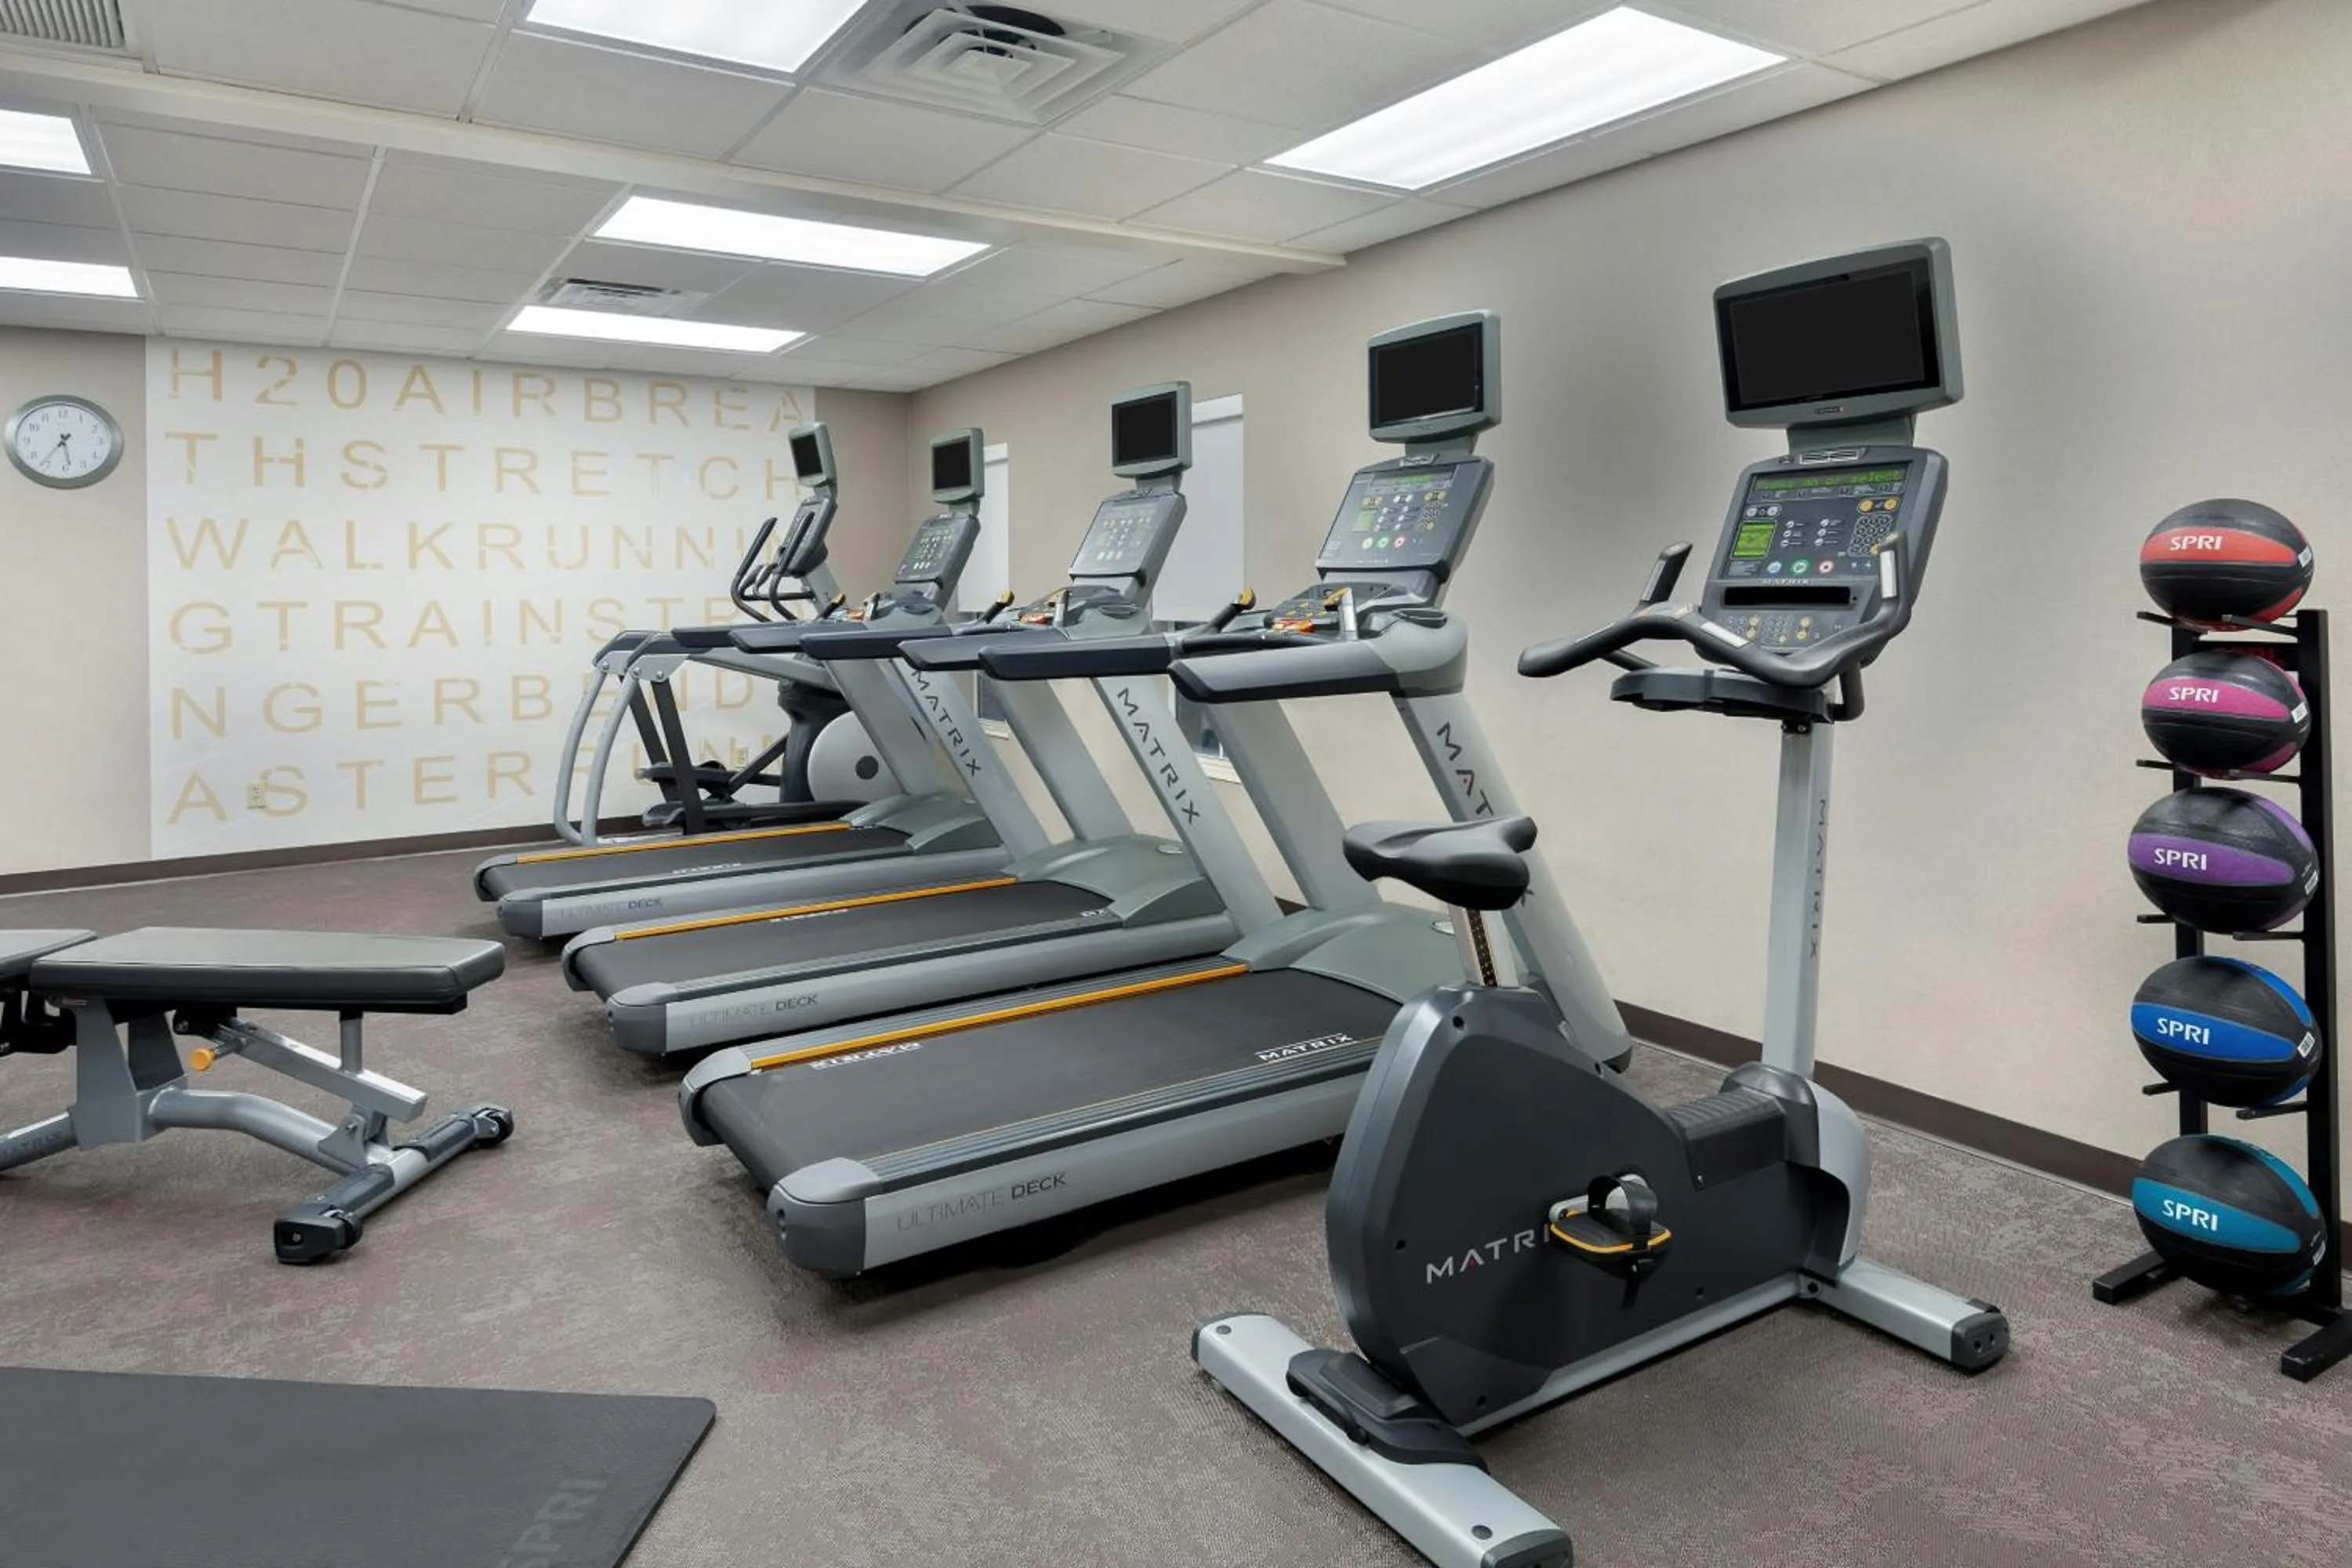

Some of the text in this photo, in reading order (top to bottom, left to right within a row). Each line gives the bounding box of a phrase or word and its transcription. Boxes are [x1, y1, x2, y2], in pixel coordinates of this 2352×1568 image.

[2169, 535, 2223, 551] SPRI
[2169, 686, 2220, 703] SPRI
[911, 670, 982, 778] MATRIX
[1116, 687, 1200, 826] MATRIX
[2154, 848, 2207, 871] SPRI
[628, 897, 664, 910] DECK
[775, 993, 818, 1012] DECK
[2157, 1017, 2210, 1046] SPRI
[1258, 1033, 1354, 1062] MATRIX
[897, 1171, 1067, 1231] ULTIMATE DECK
[2162, 1199, 2218, 1232] SPRI
[1425, 1224, 1551, 1285] MATRI
